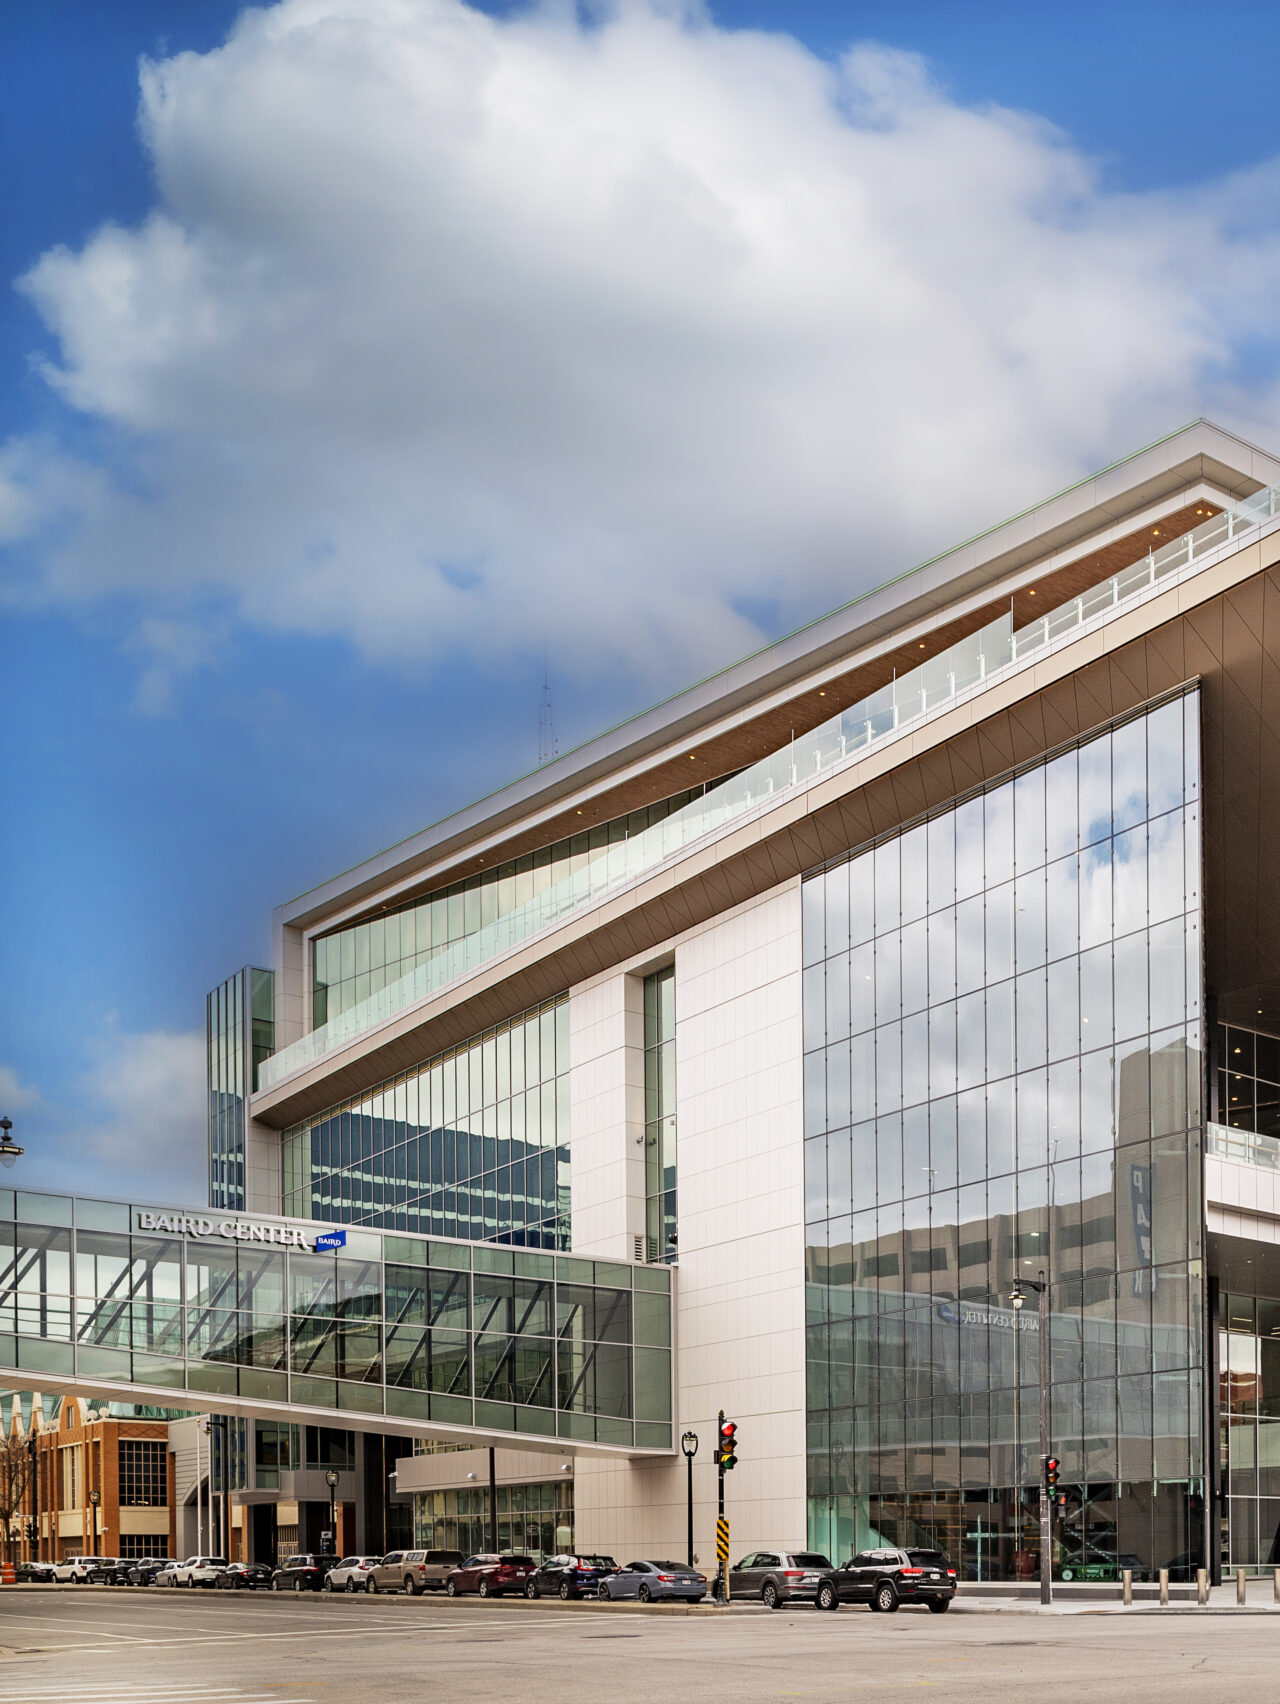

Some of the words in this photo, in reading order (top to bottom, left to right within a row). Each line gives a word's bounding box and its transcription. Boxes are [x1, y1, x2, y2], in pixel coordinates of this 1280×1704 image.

[138, 1211, 214, 1238] BAIRD
[219, 1221, 311, 1250] CENTER
[318, 1236, 342, 1247] BAIRD
